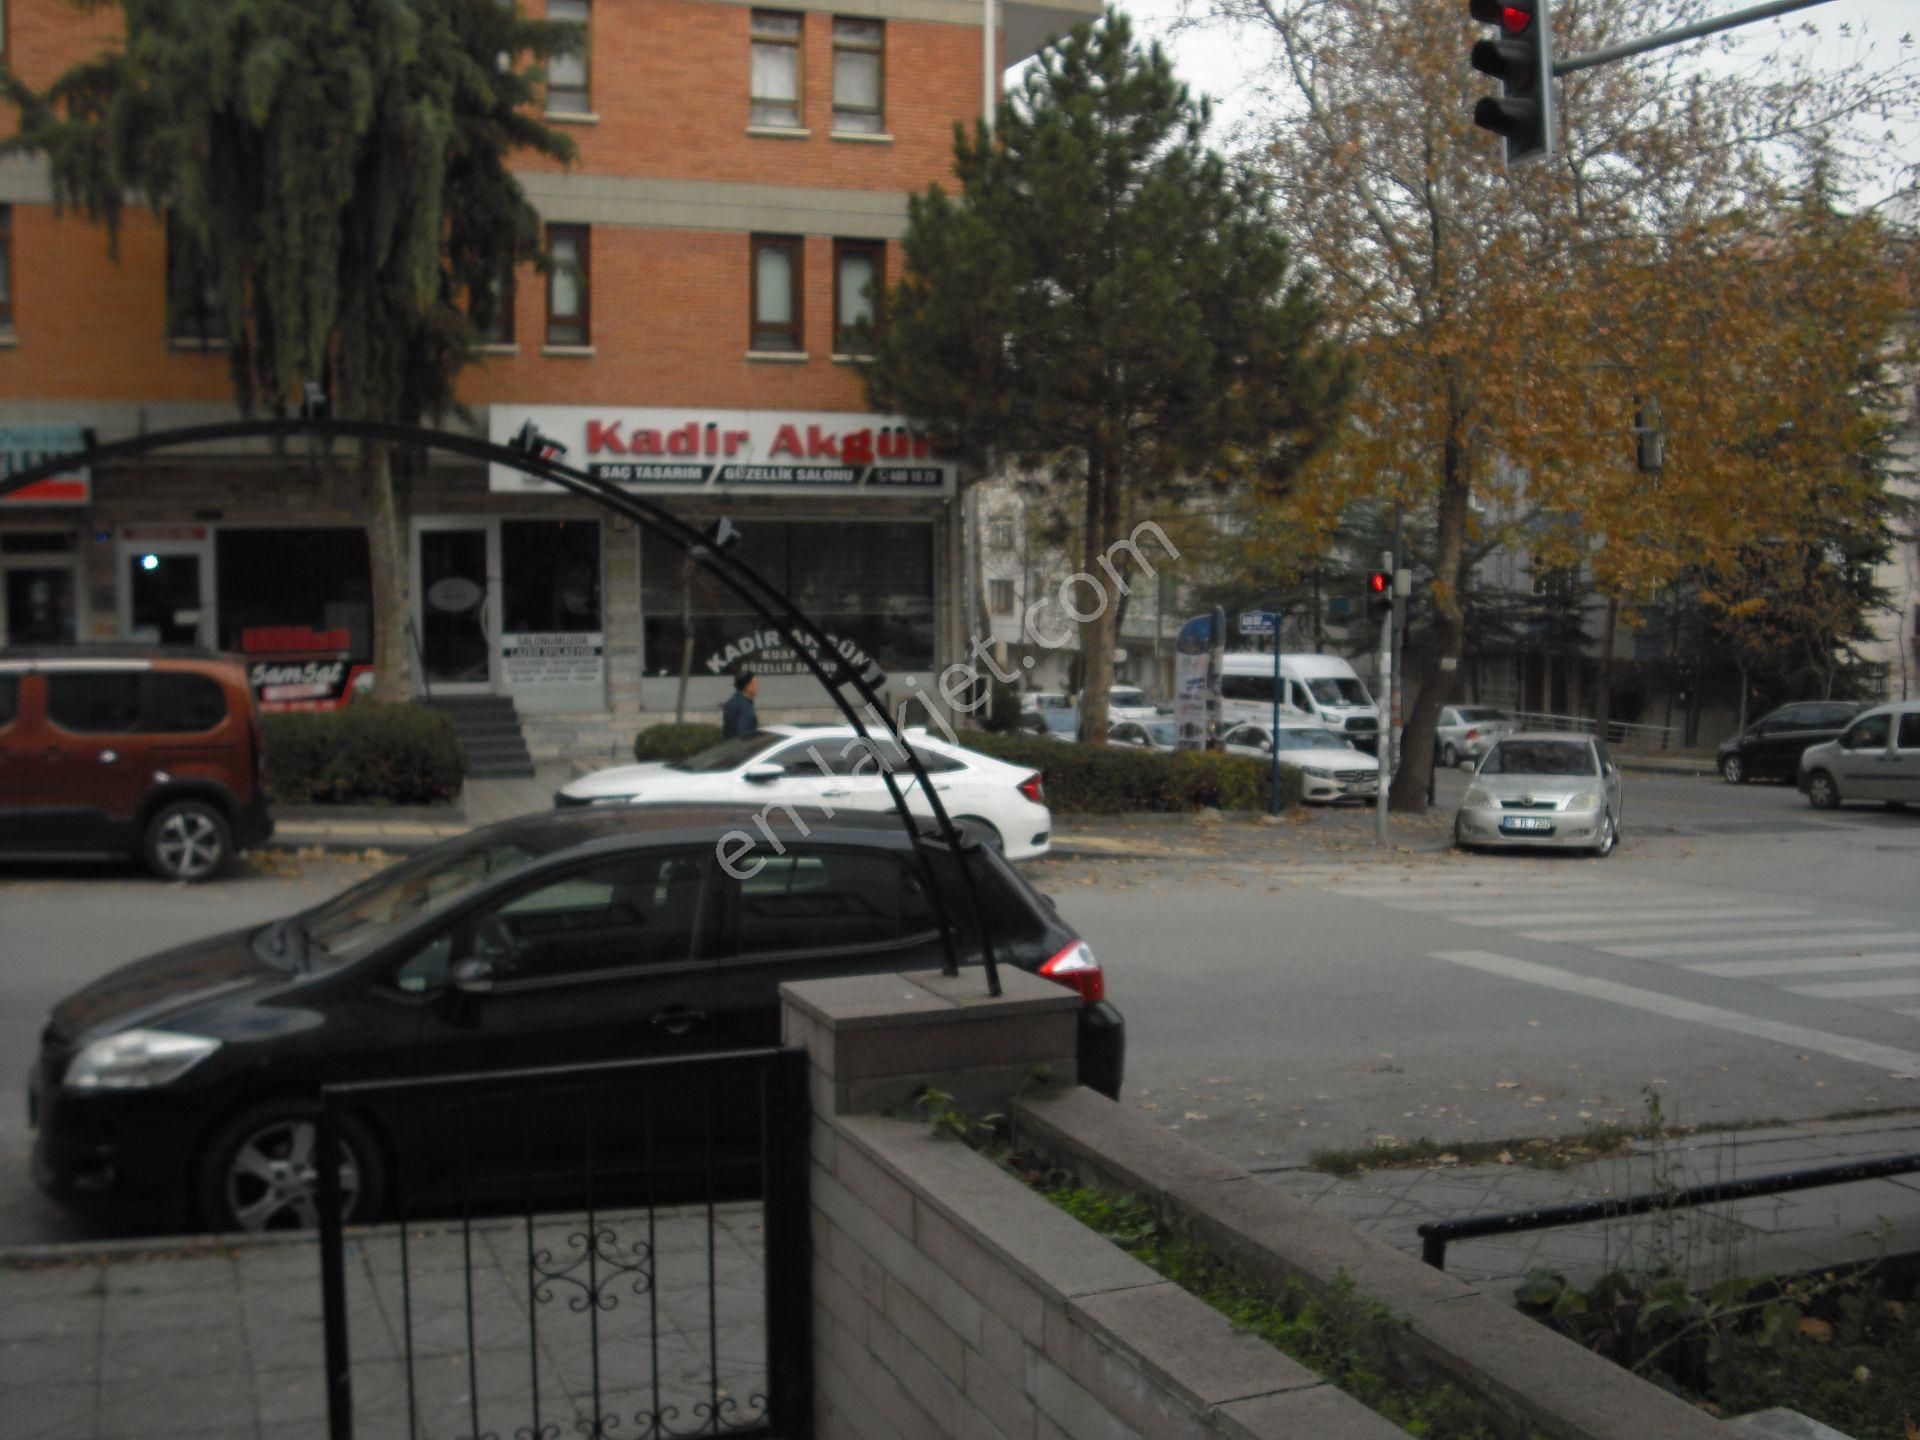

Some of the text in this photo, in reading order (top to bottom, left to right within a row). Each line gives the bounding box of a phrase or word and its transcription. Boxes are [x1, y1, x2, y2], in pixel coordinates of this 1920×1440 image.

[586, 418, 750, 457] Kadir
[600, 464, 702, 481] SAÇ TASARIM
[723, 464, 854, 482] GÜZELLİK SALONU
[706, 629, 781, 674] KADİR
